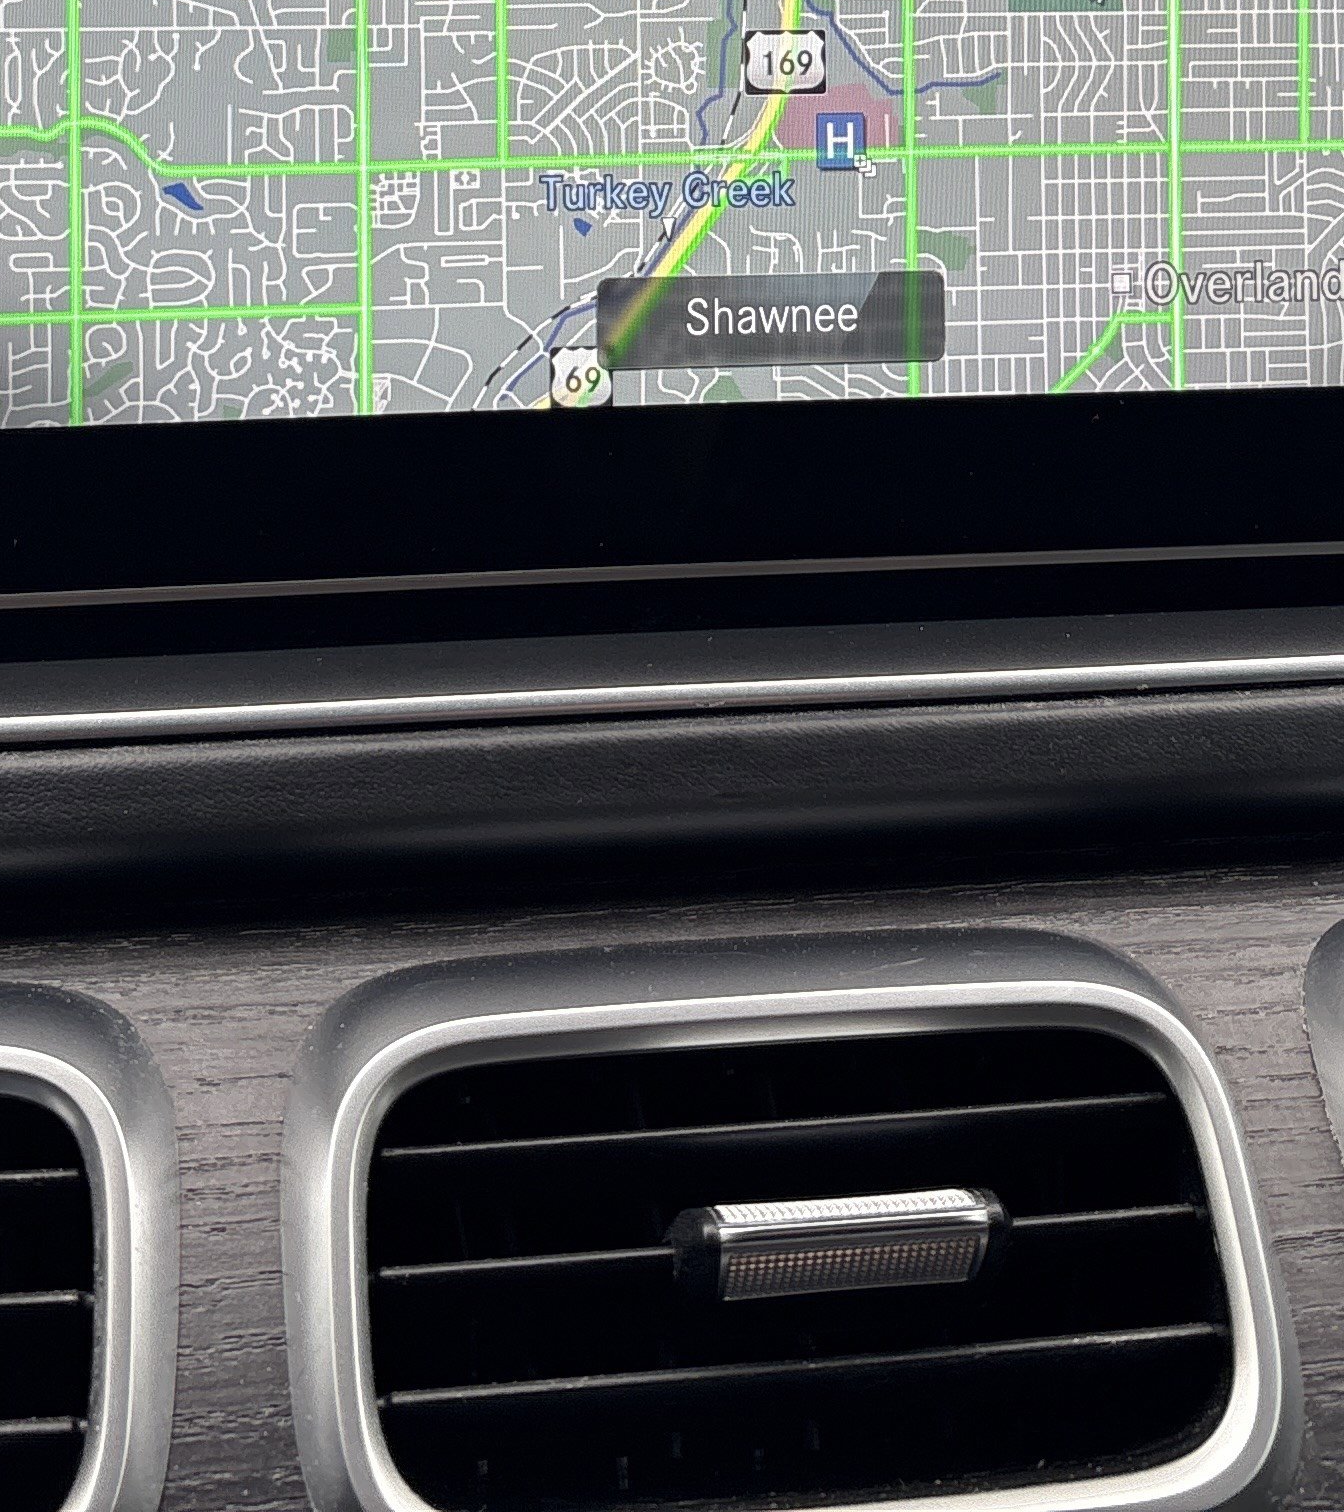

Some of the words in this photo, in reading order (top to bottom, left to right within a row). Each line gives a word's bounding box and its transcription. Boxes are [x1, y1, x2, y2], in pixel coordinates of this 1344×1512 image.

[762, 49, 814, 77] 169
[826, 121, 854, 160] H
[539, 173, 672, 219] Turkey
[682, 170, 795, 209] Creek
[685, 297, 858, 336] Shawnee
[564, 366, 602, 393] 69
